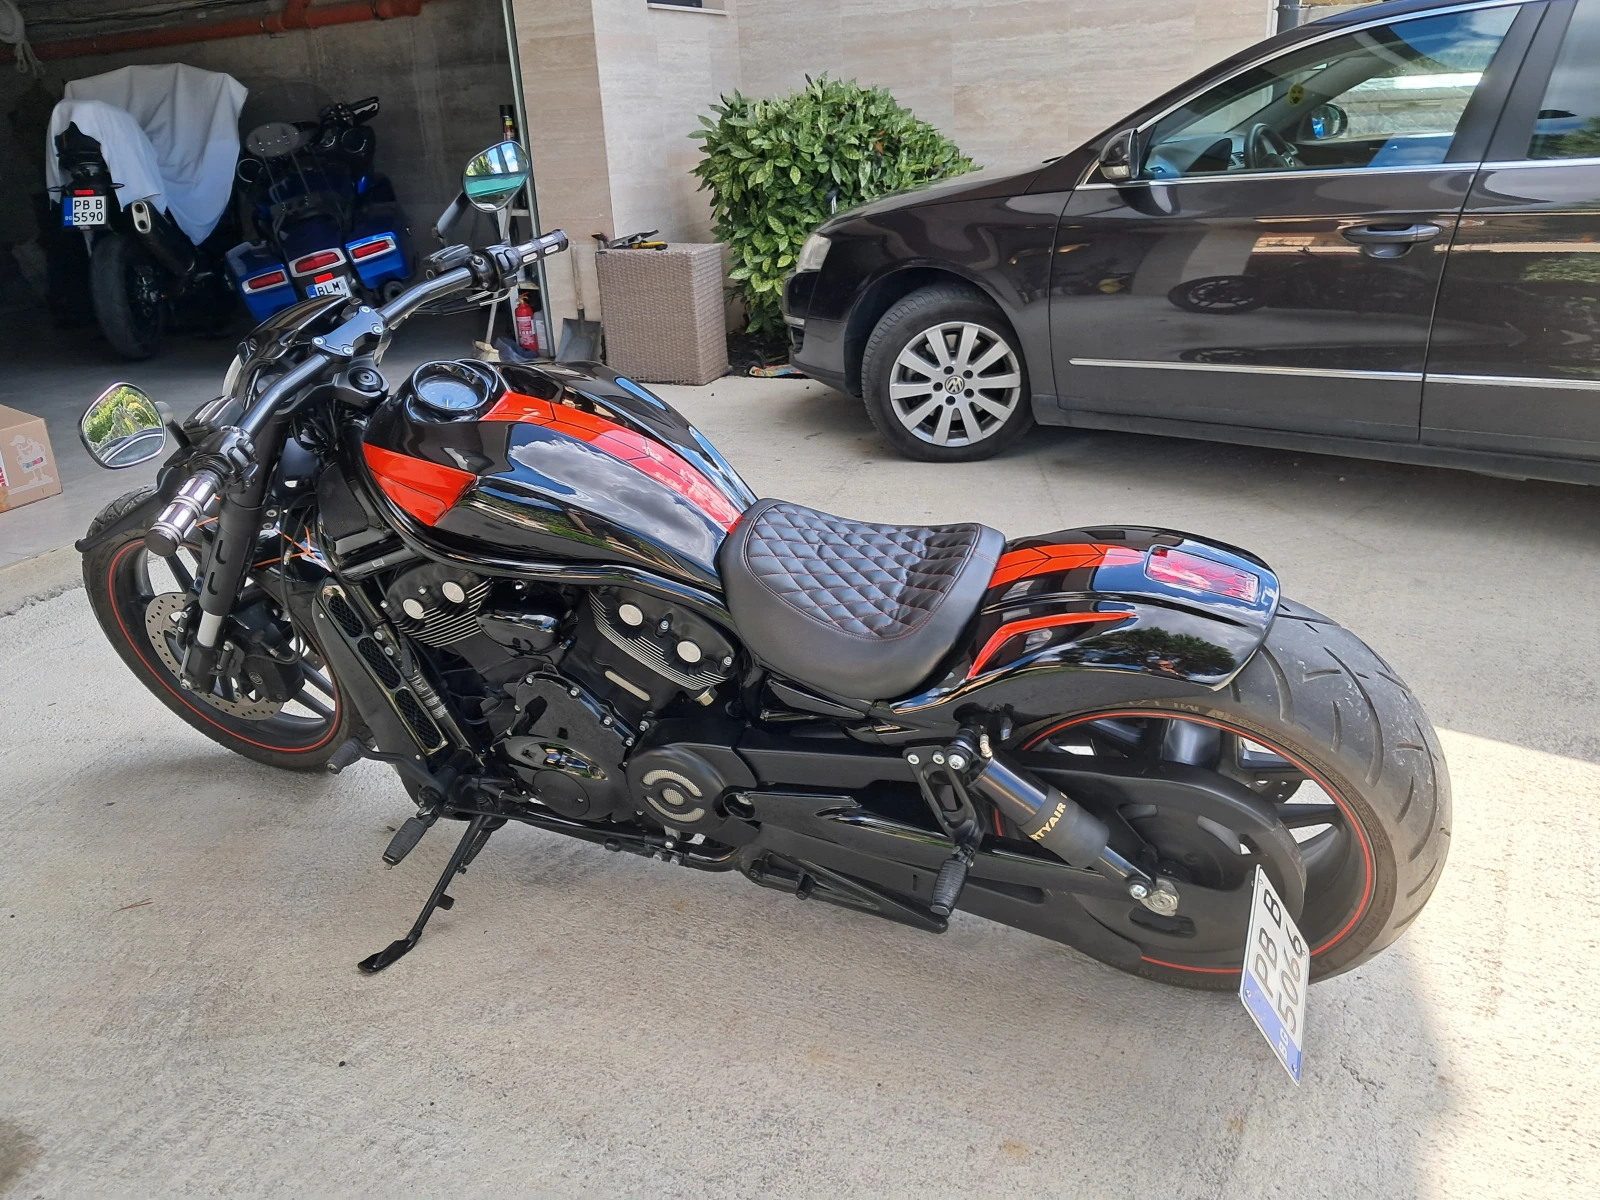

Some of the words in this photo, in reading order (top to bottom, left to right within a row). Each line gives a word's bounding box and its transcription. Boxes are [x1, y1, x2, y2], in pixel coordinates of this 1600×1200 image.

[73, 211, 103, 222] 5590
[74, 200, 90, 210] PB
[95, 199, 103, 210] B
[1263, 888, 1282, 929] B
[1254, 927, 1278, 999] PB
[1278, 923, 1303, 1036] 5066
[1278, 1027, 1289, 1061] BG
